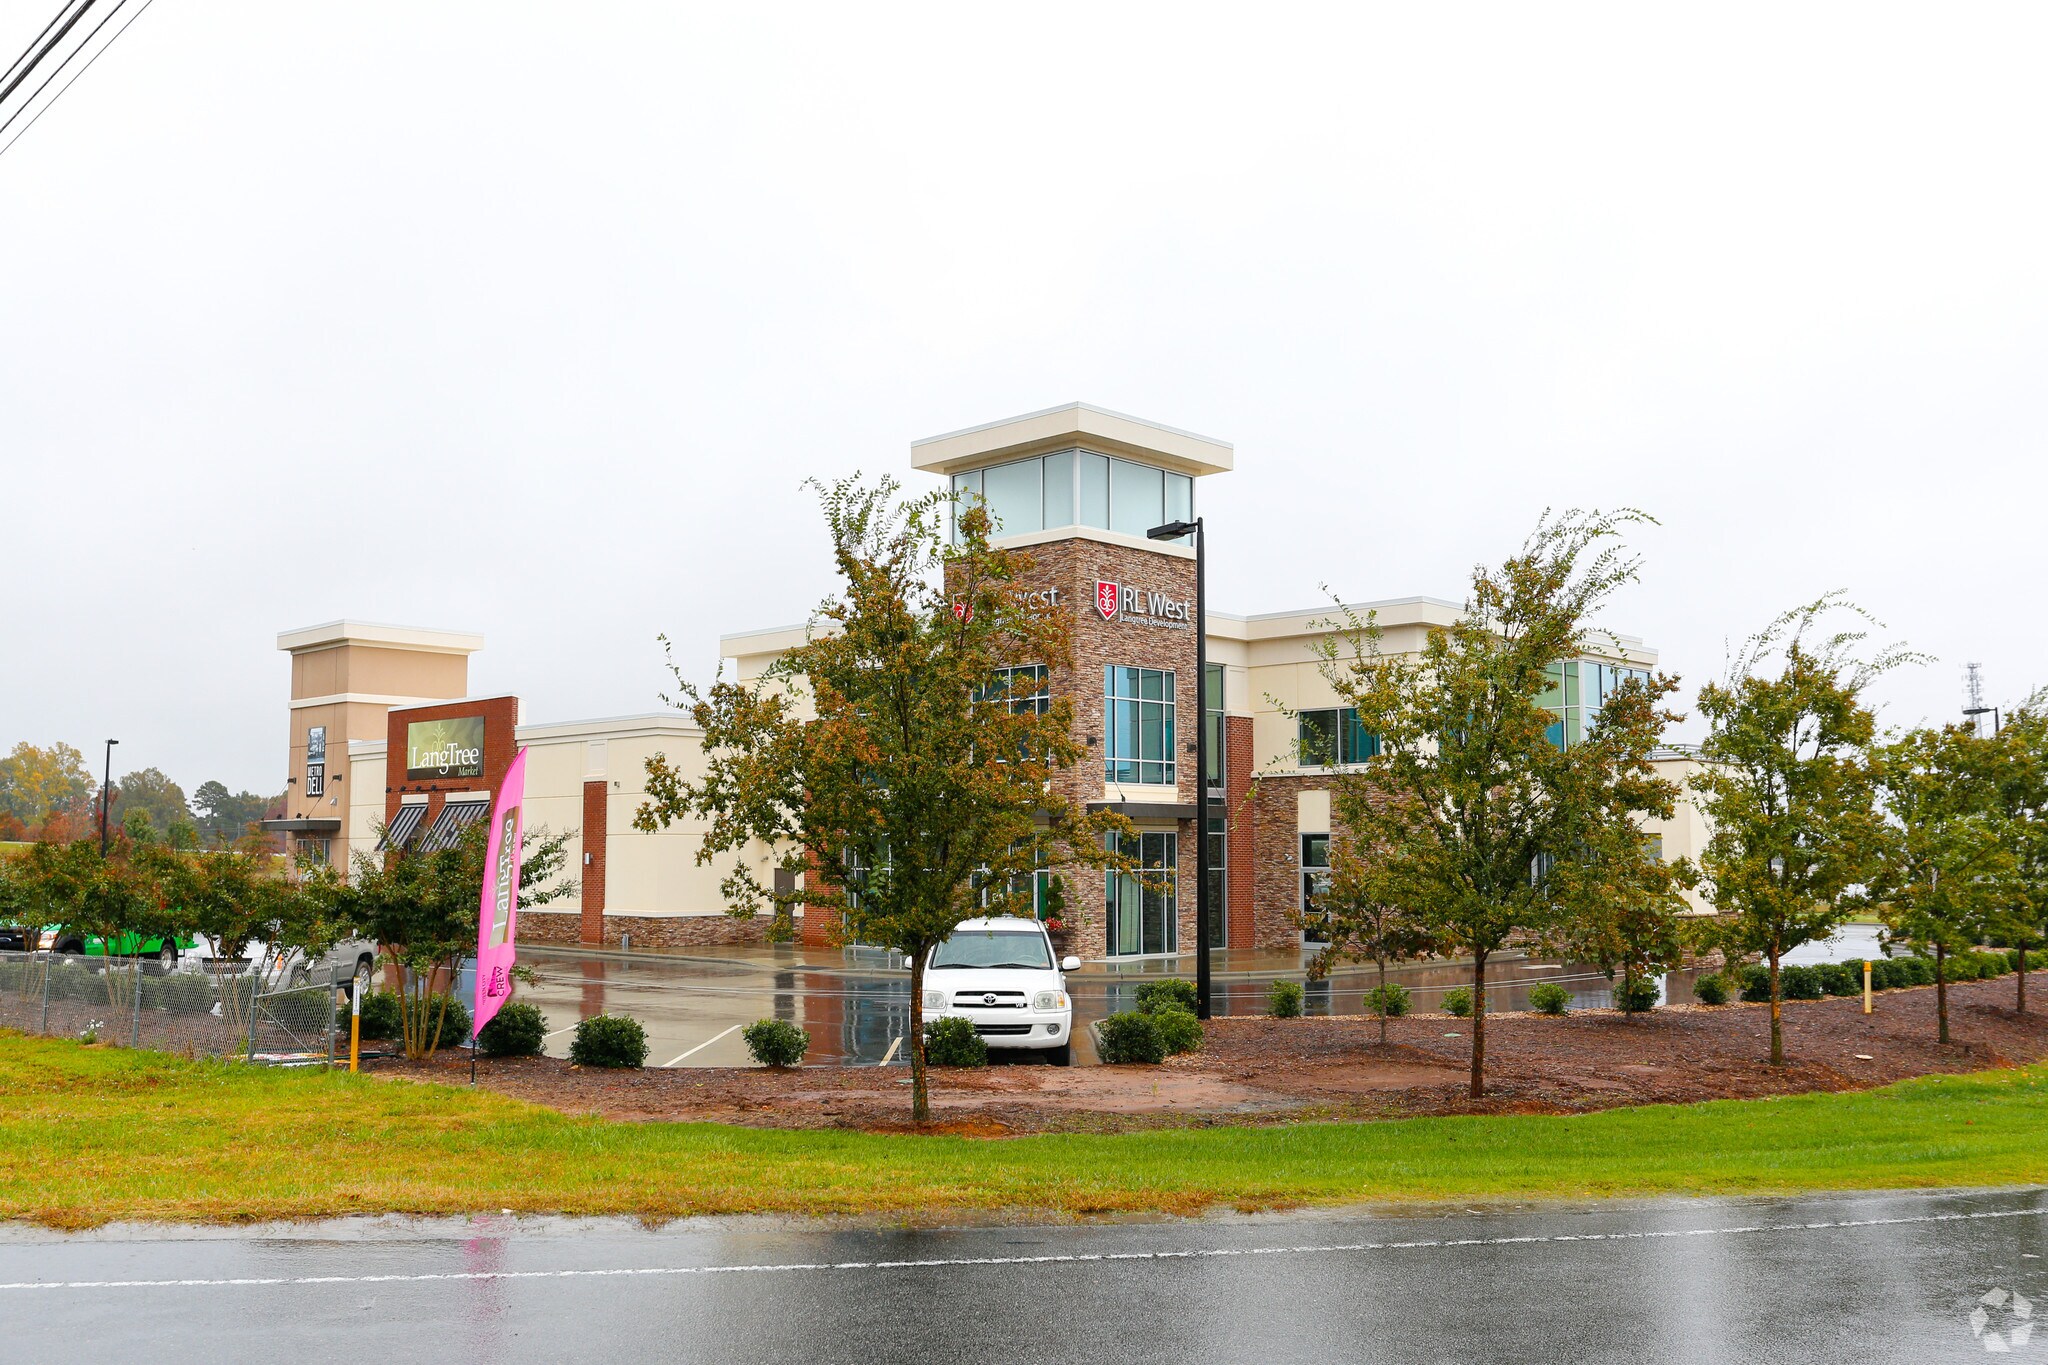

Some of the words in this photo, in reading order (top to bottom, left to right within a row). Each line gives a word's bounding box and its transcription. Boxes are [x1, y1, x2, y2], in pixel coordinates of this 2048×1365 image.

[1122, 587, 1145, 613] RL
[1148, 591, 1190, 620] West
[1121, 614, 1148, 625] Langtree
[1149, 618, 1188, 630] Development
[411, 742, 479, 775] LangTree
[457, 766, 479, 776] Market
[492, 818, 514, 931] LangTree
[496, 966, 505, 997] CREW
